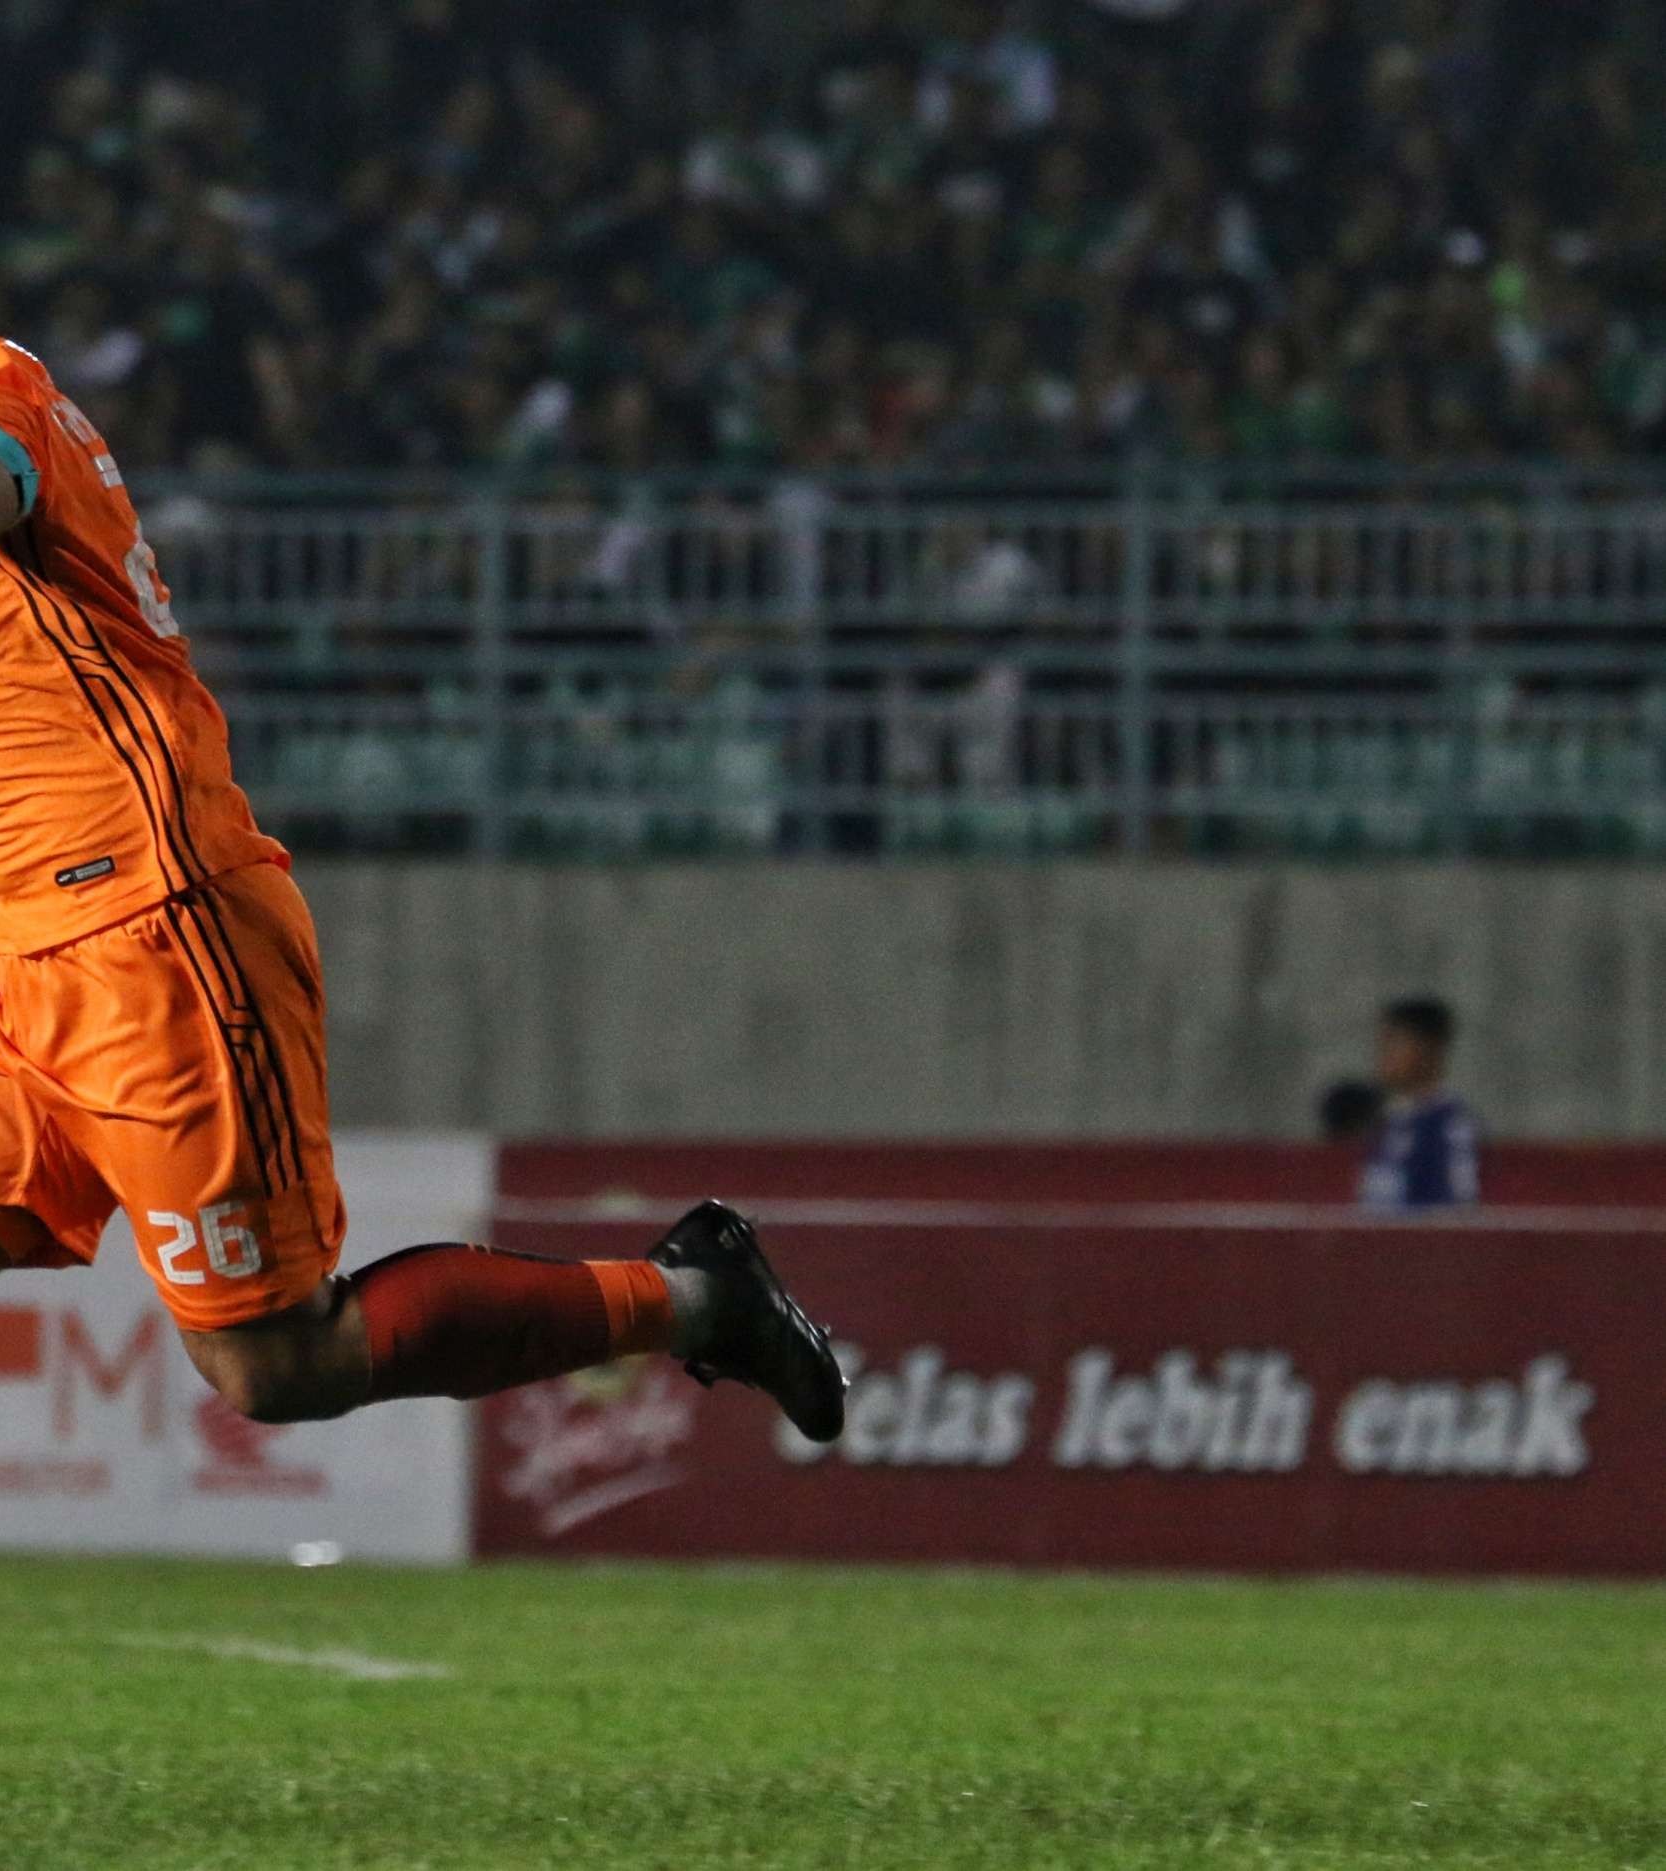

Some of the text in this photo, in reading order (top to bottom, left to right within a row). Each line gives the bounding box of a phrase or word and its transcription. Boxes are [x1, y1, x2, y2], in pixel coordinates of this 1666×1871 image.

[146, 1200, 263, 1286] 26
[1052, 1346, 1314, 1473] lebih
[1336, 1350, 1594, 1477] enak
